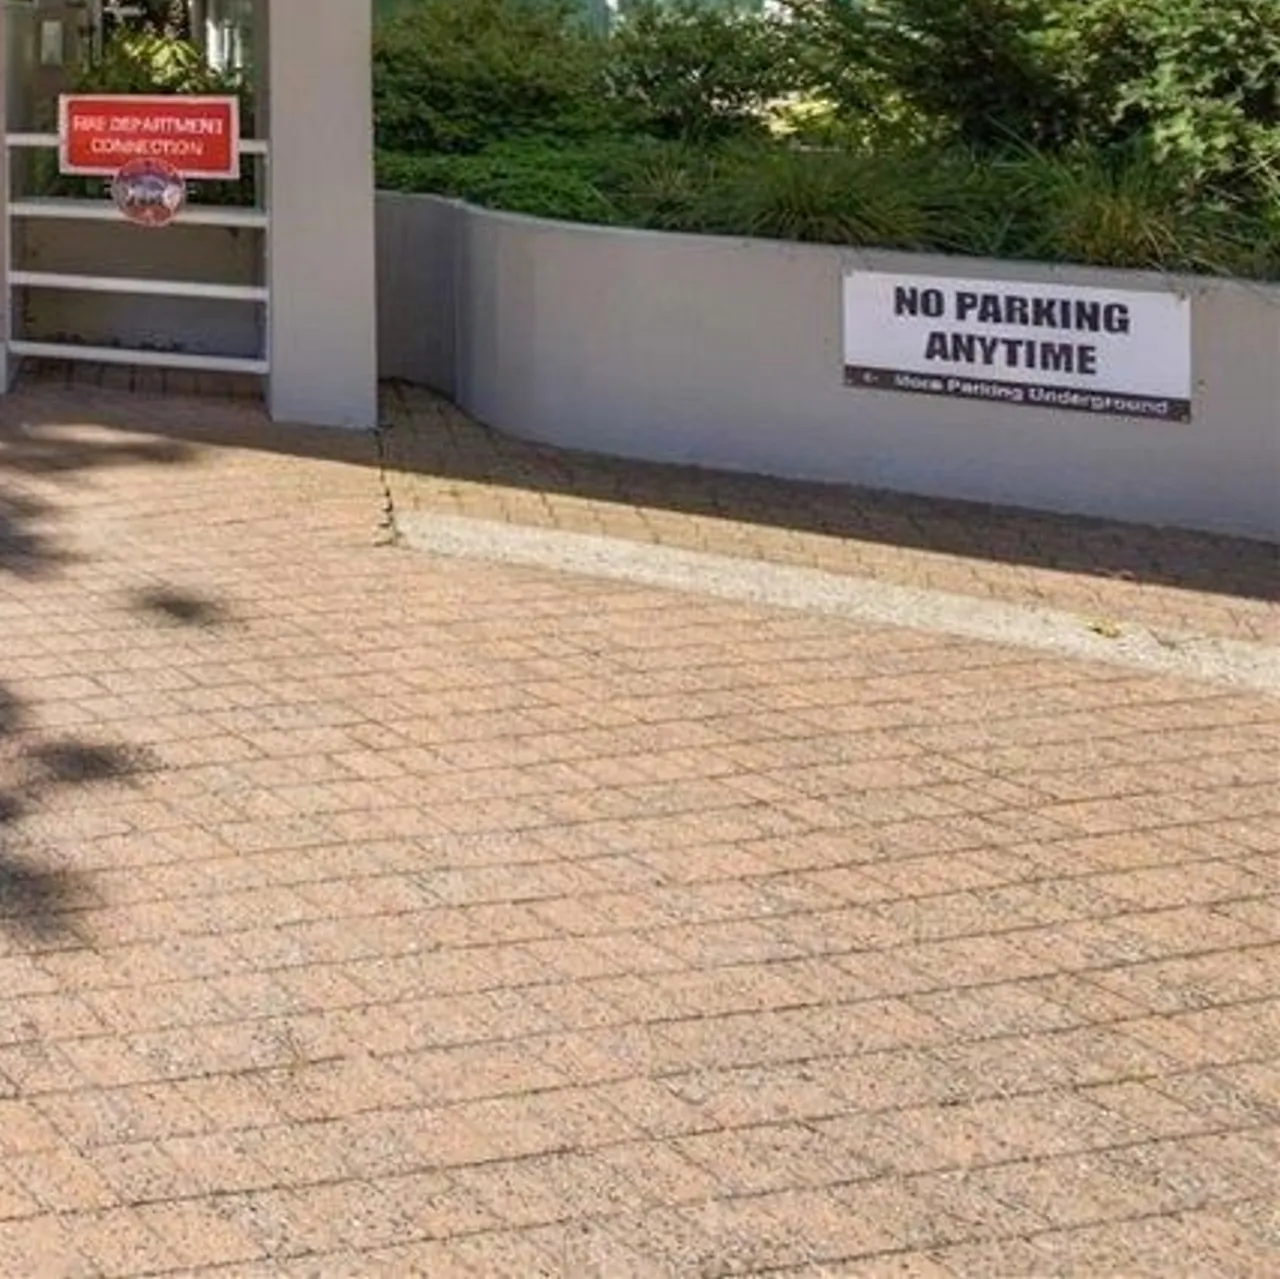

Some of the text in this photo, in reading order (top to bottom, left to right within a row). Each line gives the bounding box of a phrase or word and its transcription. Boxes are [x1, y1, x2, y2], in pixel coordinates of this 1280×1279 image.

[73, 114, 224, 135] FIRE DEPARTMENT
[91, 138, 204, 156] CONNECTION
[894, 286, 1130, 334] NO PARKING
[924, 331, 1098, 374] ANYTIME
[894, 374, 1168, 415] More Parking Underground
